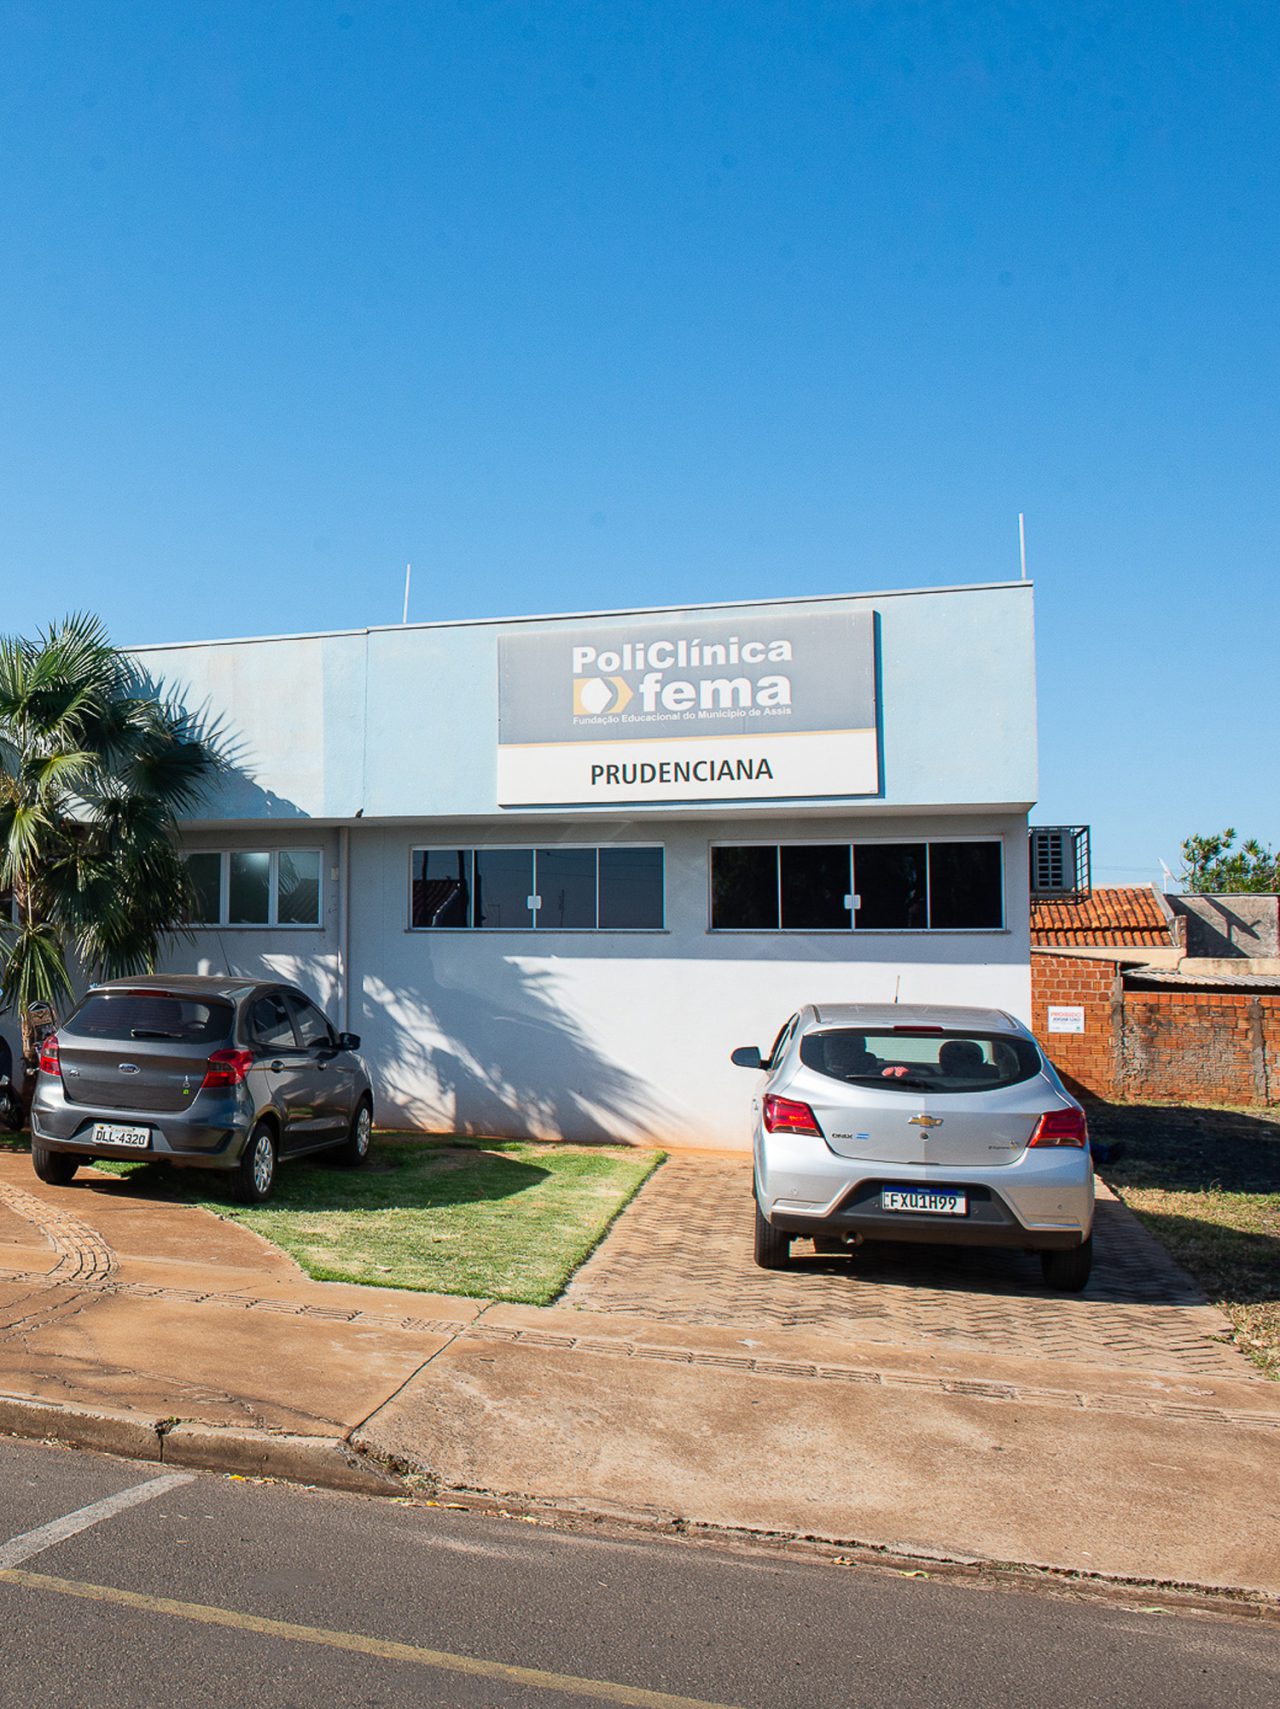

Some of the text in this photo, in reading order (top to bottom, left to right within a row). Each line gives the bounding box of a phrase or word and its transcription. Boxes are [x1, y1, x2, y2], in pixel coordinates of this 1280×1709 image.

[572, 636, 793, 674] PoliClínica
[639, 672, 792, 712] fema
[572, 715, 620, 726] Fundação
[621, 711, 681, 723] Educacional
[682, 711, 696, 720] do
[748, 707, 761, 716] de
[763, 702, 792, 716] Assis
[591, 758, 774, 785] PRUDENCIANA
[890, 1193, 957, 1210] FXU1H99
